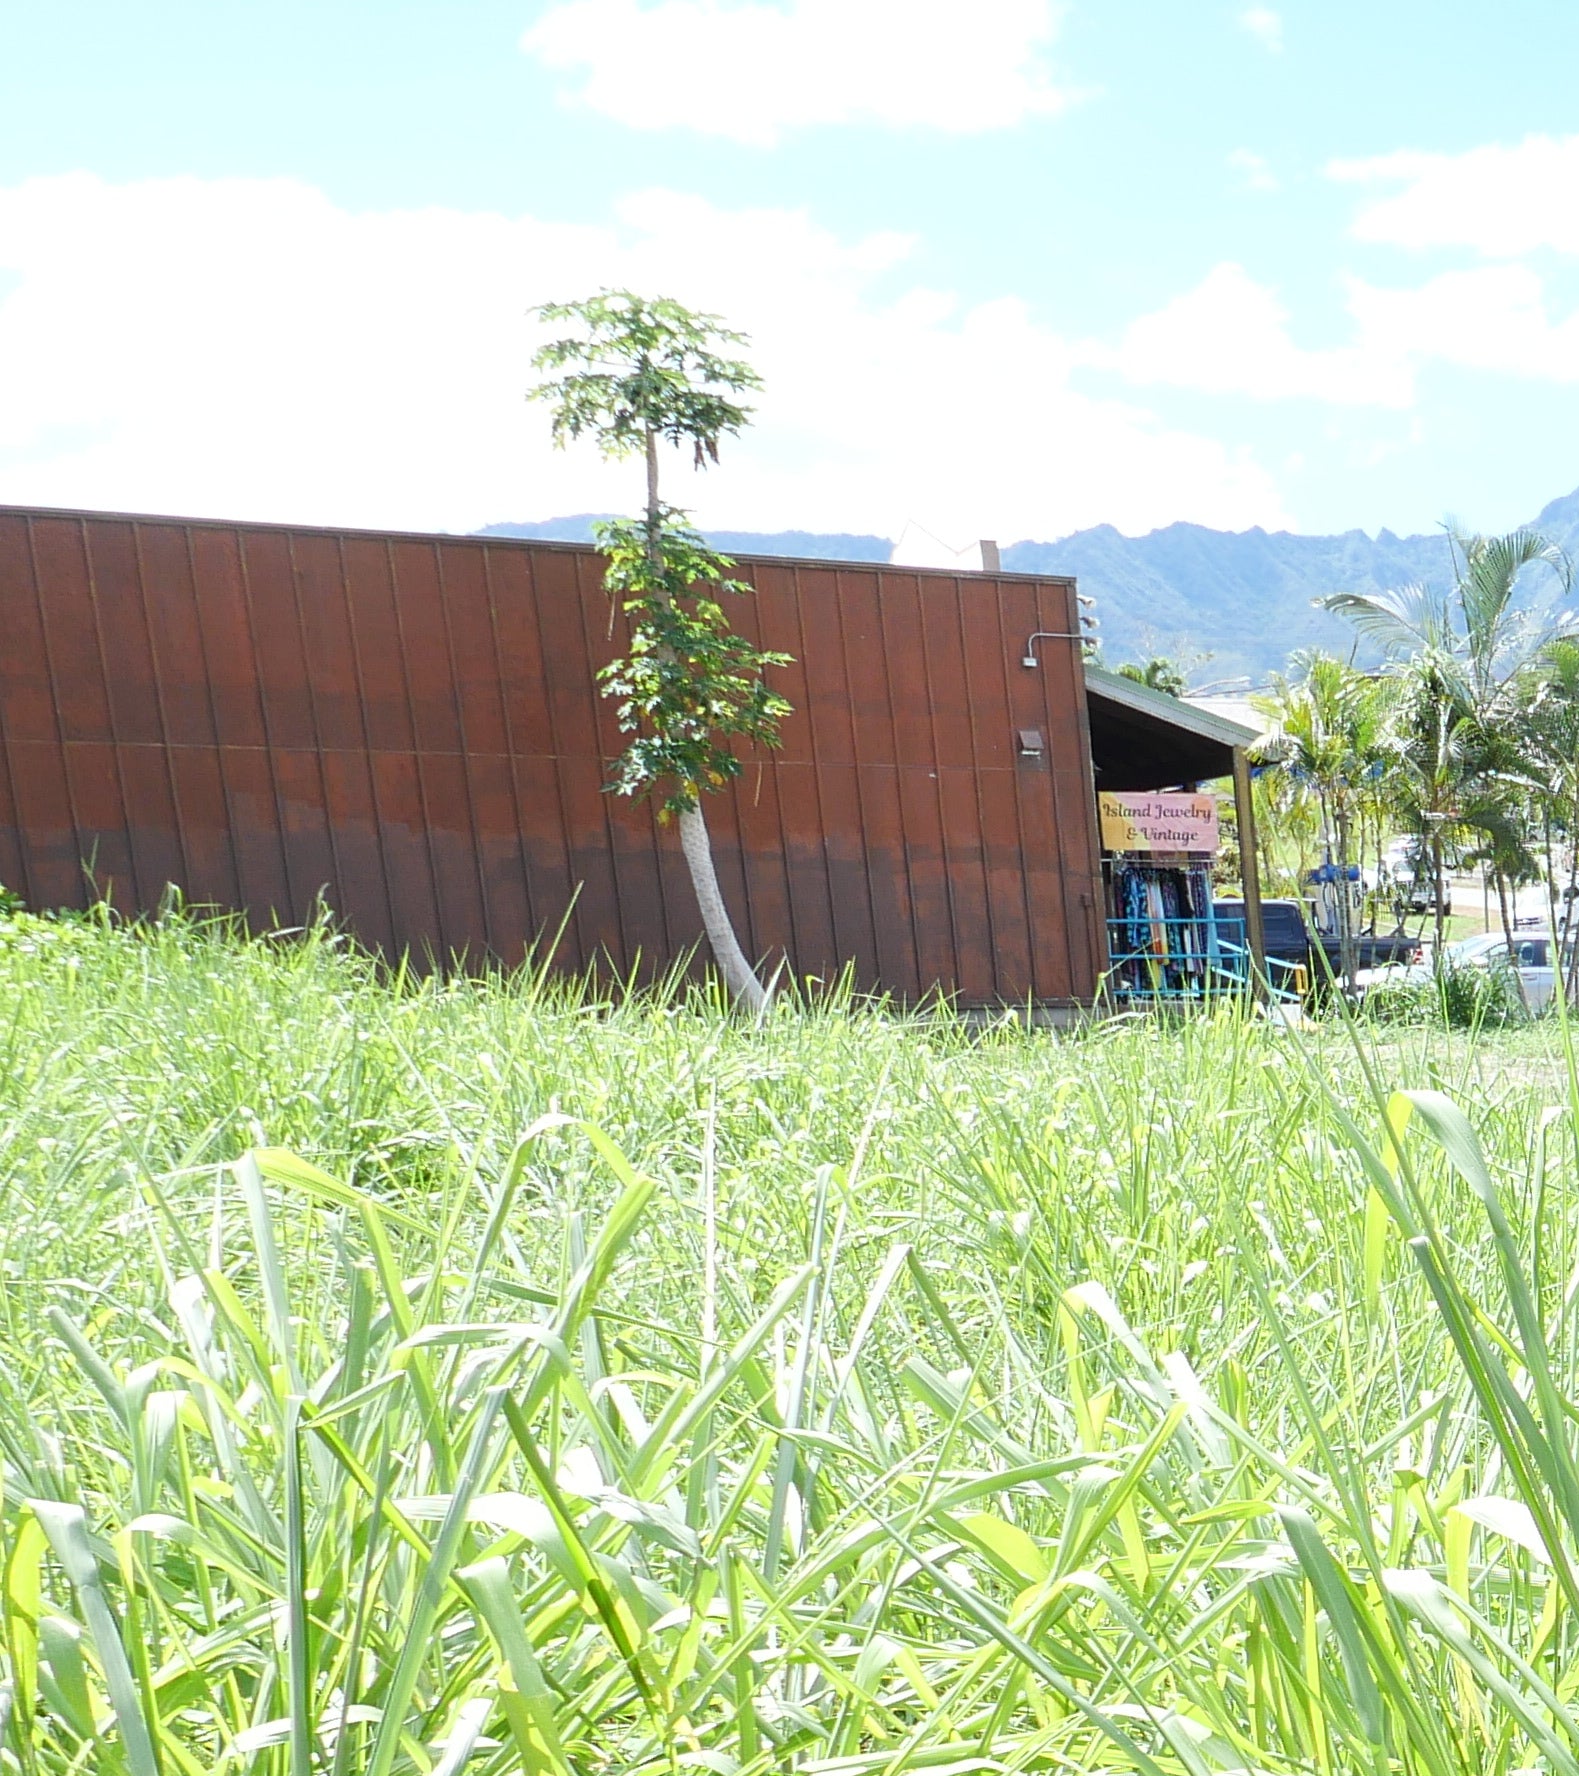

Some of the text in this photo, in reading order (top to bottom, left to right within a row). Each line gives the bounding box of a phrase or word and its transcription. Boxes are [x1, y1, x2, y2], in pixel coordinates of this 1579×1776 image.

[1102, 803, 1212, 824] Island Jewelry
[1126, 826, 1200, 846] & Vintage
